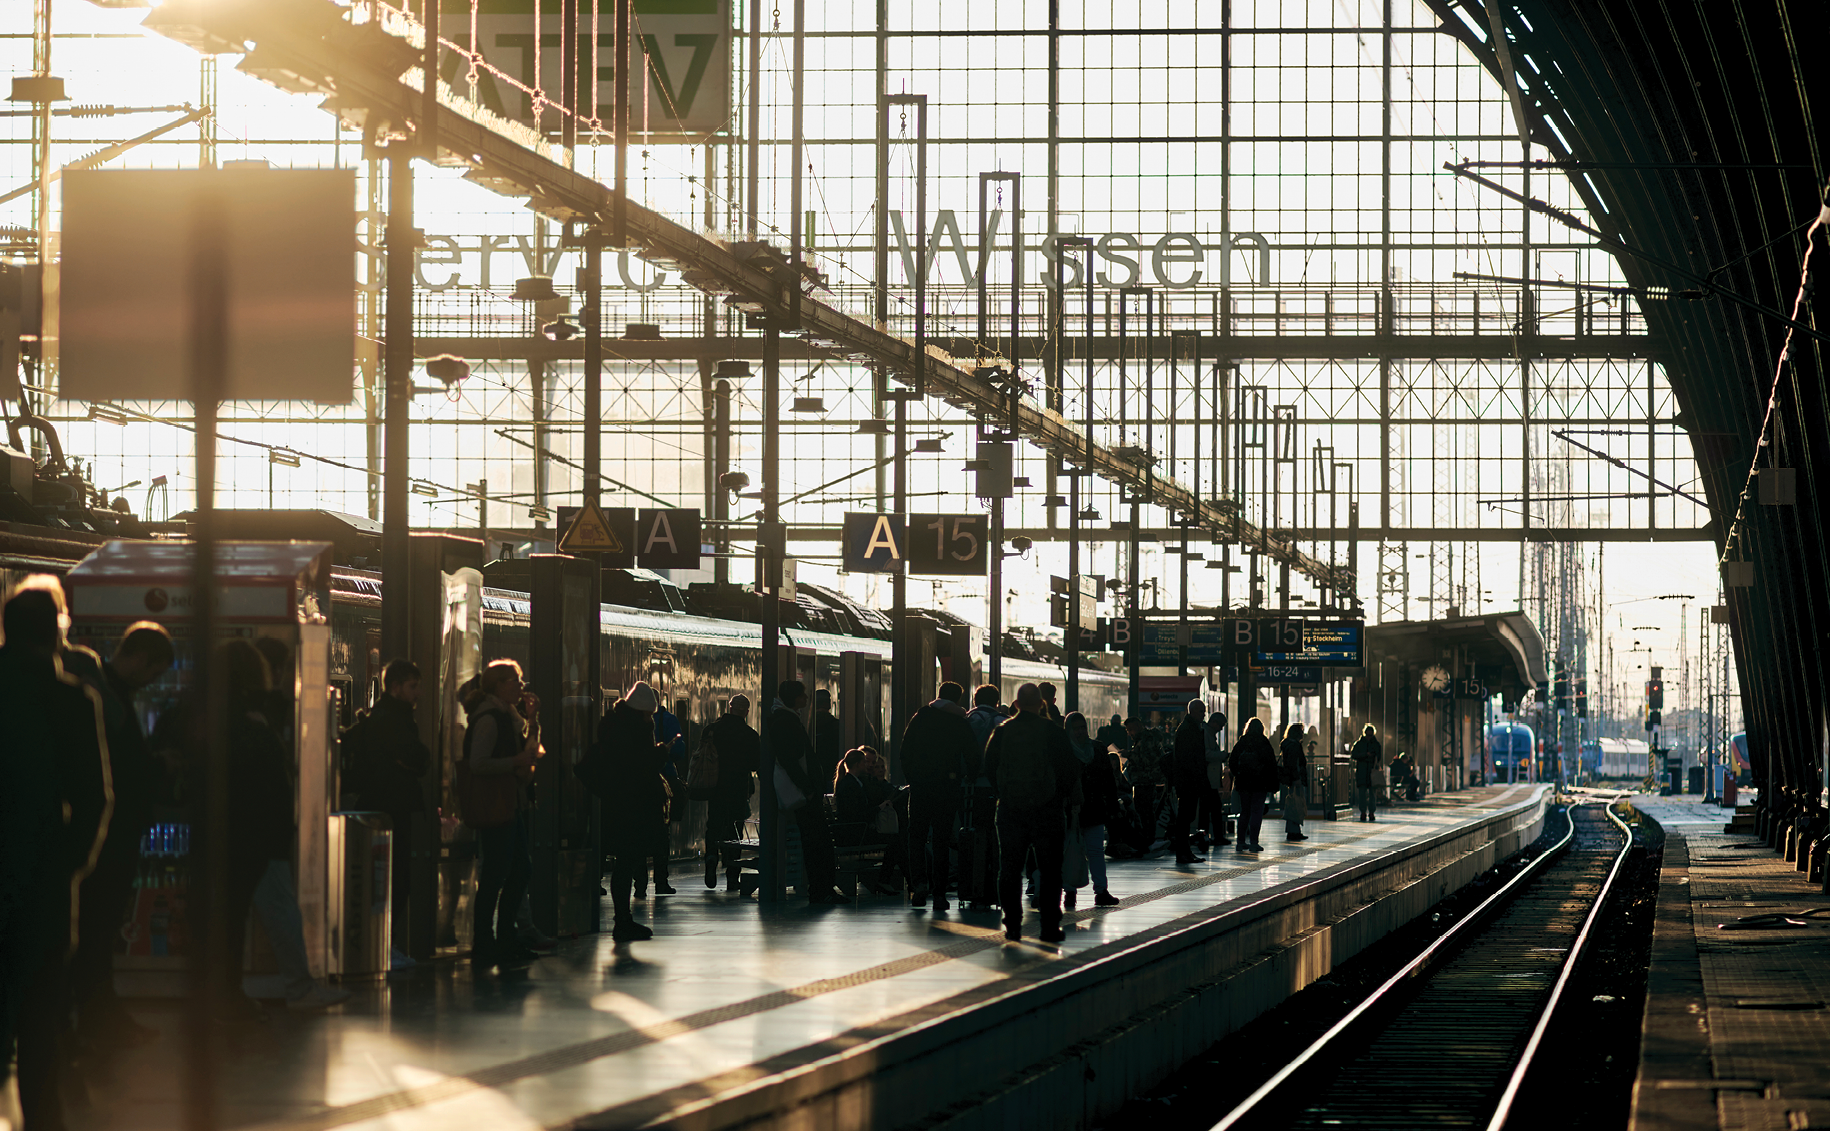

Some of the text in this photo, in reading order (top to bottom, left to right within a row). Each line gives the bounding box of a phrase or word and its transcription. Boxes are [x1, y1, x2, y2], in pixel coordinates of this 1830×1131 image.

[437, 34, 719, 120] ATEV
[889, 210, 1272, 288] Wissen
[643, 511, 679, 555] A
[863, 515, 979, 561] A 15
[1113, 619, 1131, 643] B
[1235, 620, 1299, 645] B 15
[1303, 635, 1343, 644] rg-Stockheim
[1267, 666, 1299, 678] 16-24
[1462, 679, 1480, 695] 15
